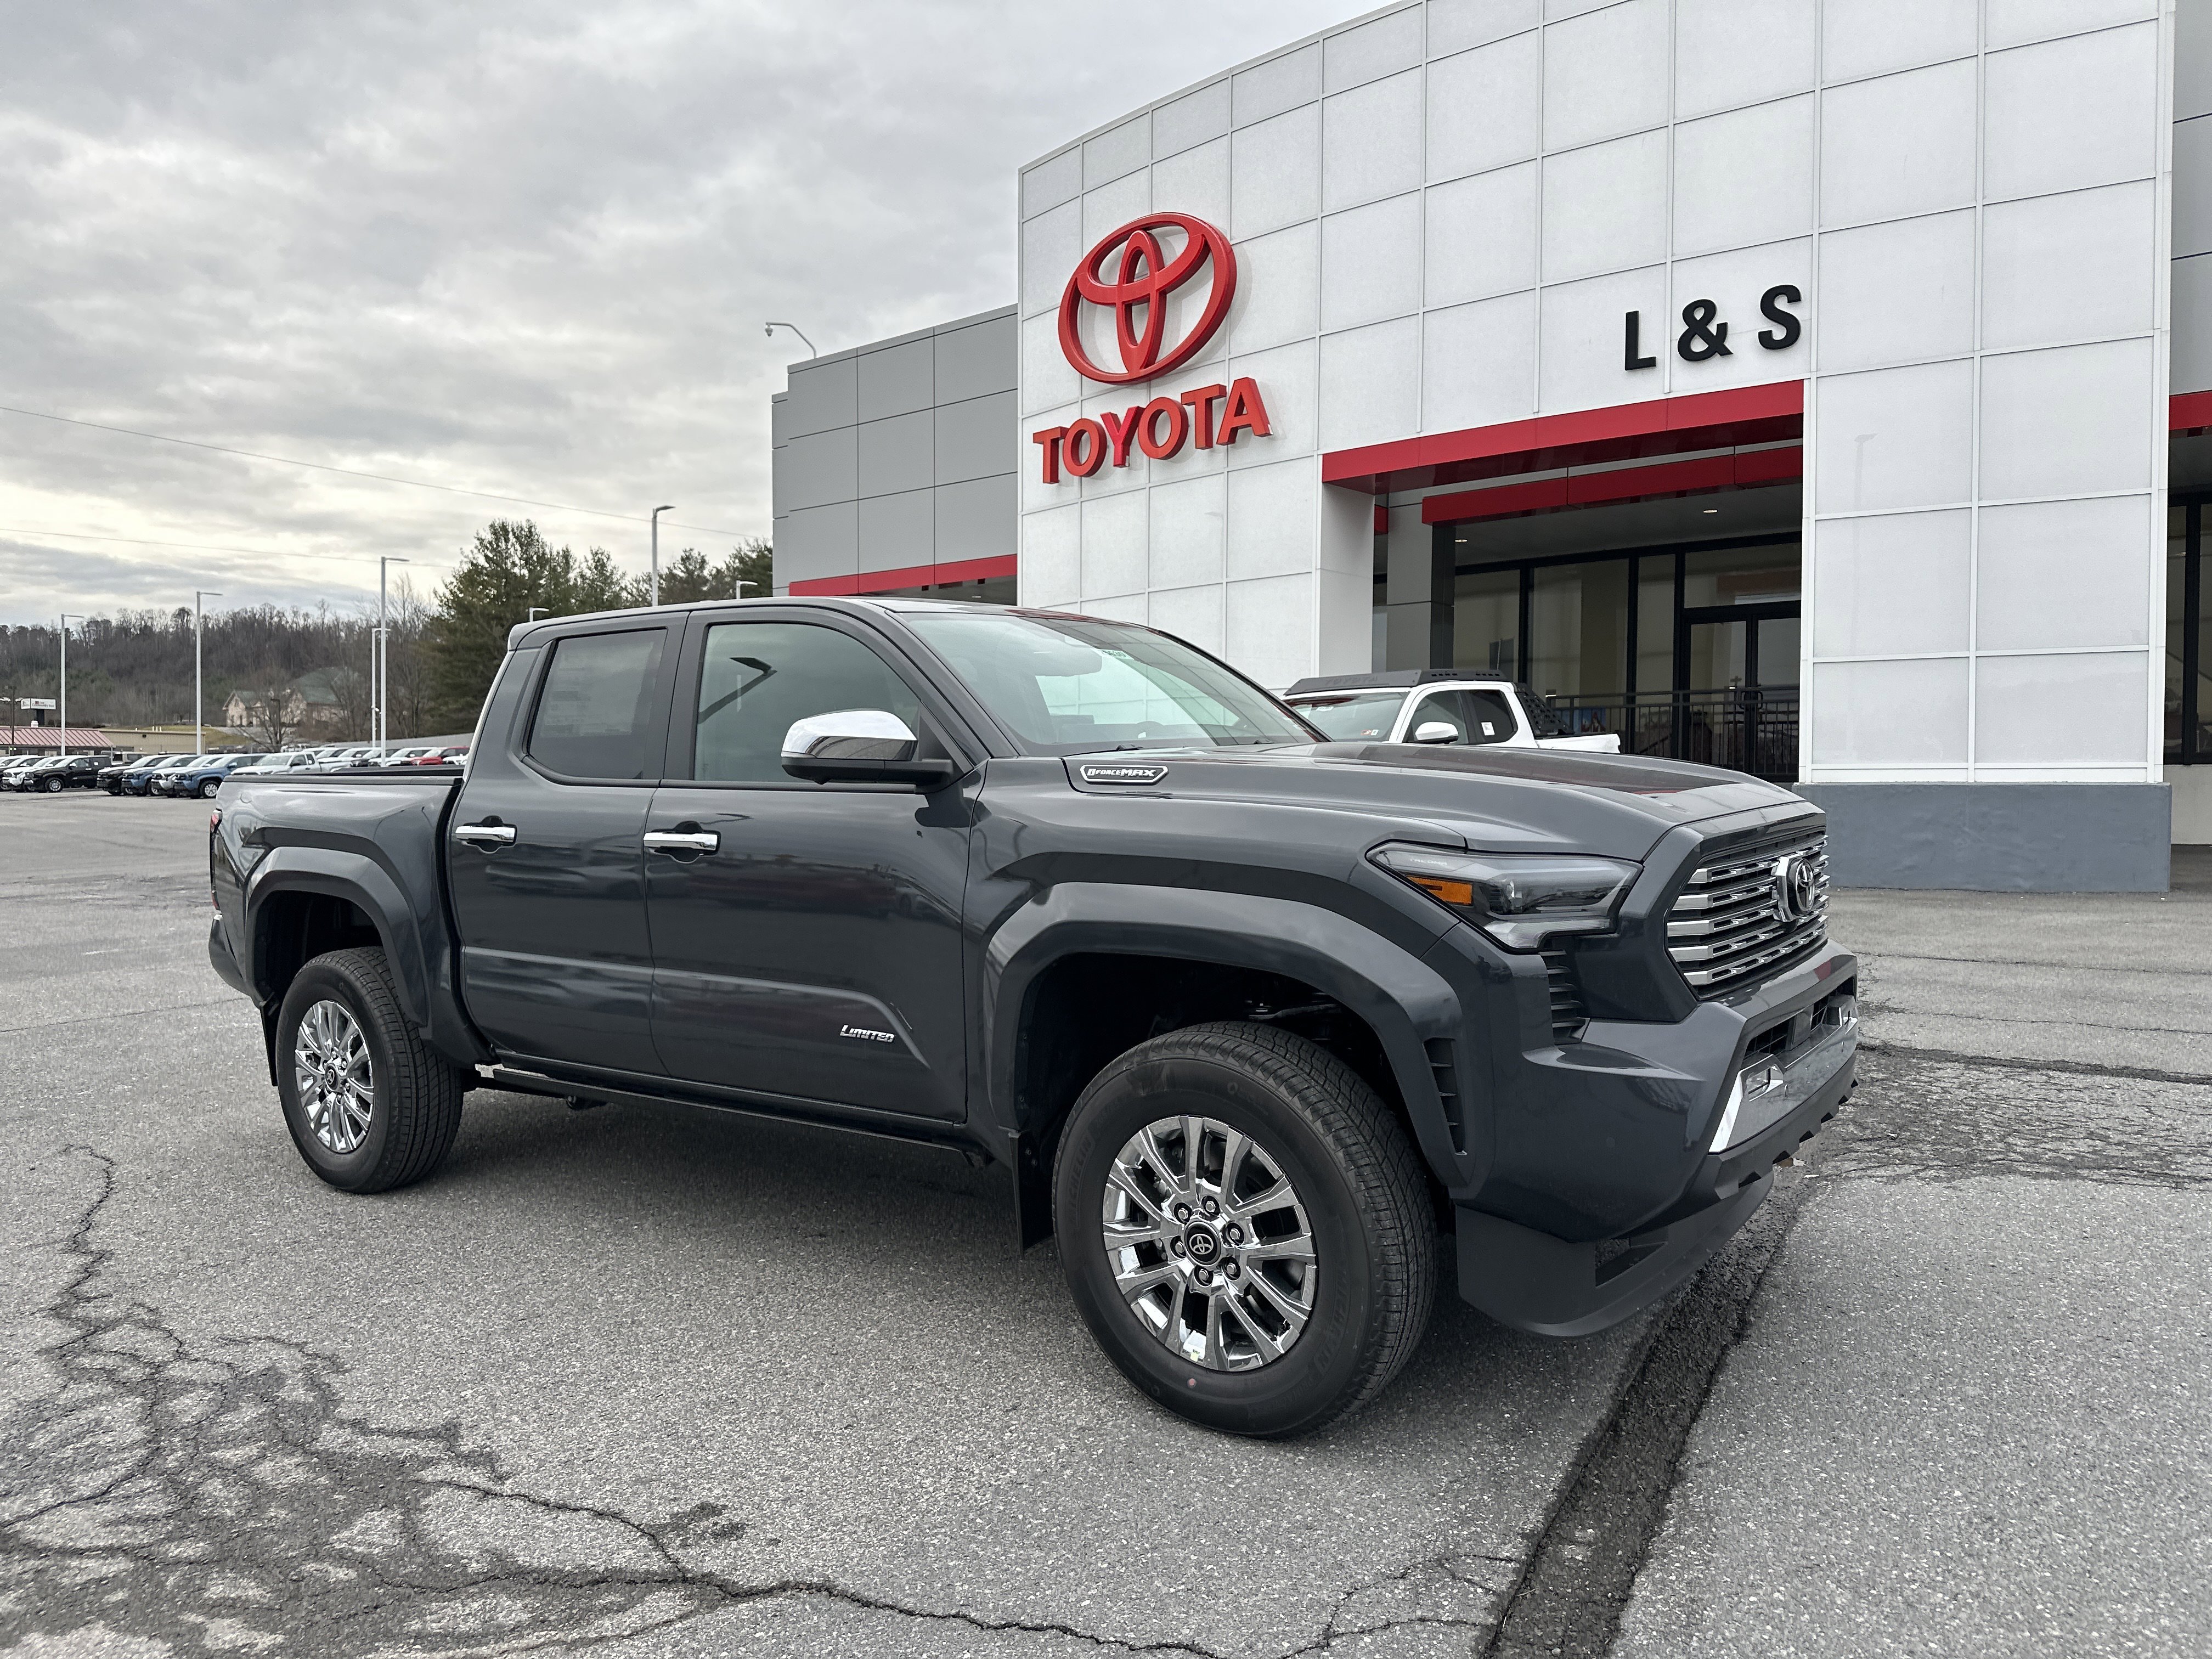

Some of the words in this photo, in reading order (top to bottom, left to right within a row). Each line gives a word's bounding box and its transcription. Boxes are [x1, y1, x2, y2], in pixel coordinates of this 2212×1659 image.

[1625, 311, 1656, 370] L
[1678, 299, 1734, 362] &
[1758, 284, 1802, 350] S
[1033, 377, 1273, 484] TOYOTA
